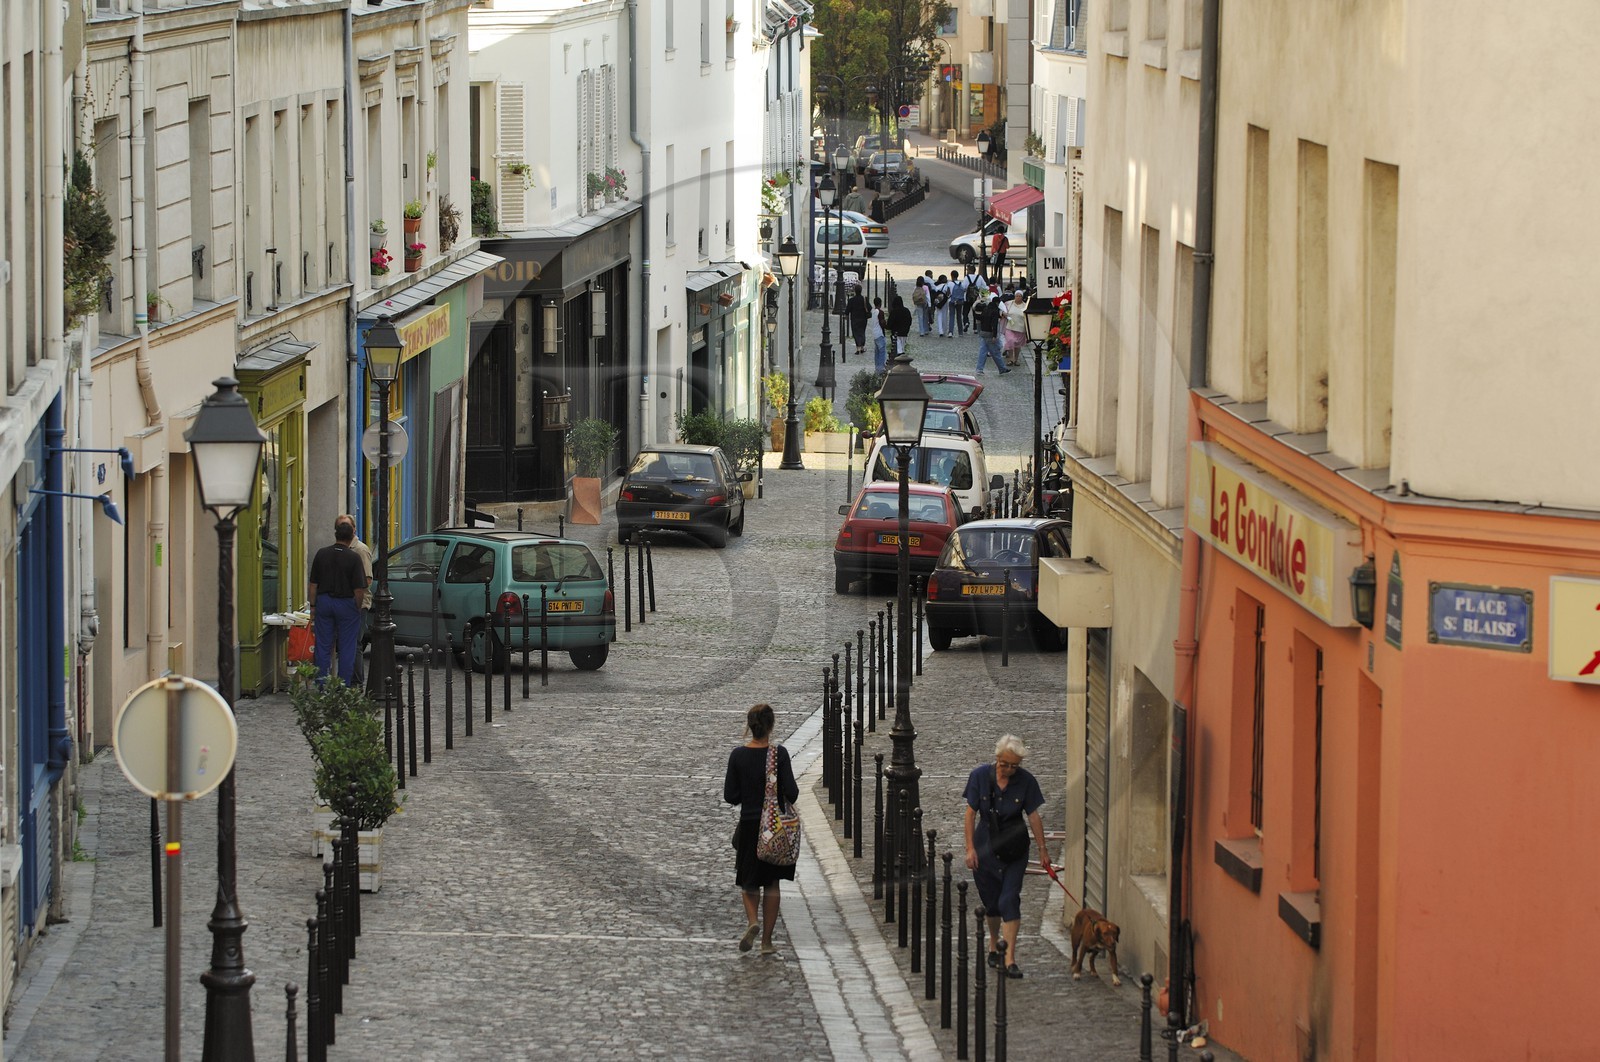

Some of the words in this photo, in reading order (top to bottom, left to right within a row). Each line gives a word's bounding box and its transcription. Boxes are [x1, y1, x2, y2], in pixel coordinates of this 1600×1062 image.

[1044, 257, 1066, 270] L'IM
[1210, 465, 1229, 544] La
[1235, 482, 1307, 595] Gondole
[1455, 596, 1507, 616] PLACE
[1463, 618, 1517, 637] BLAISE
